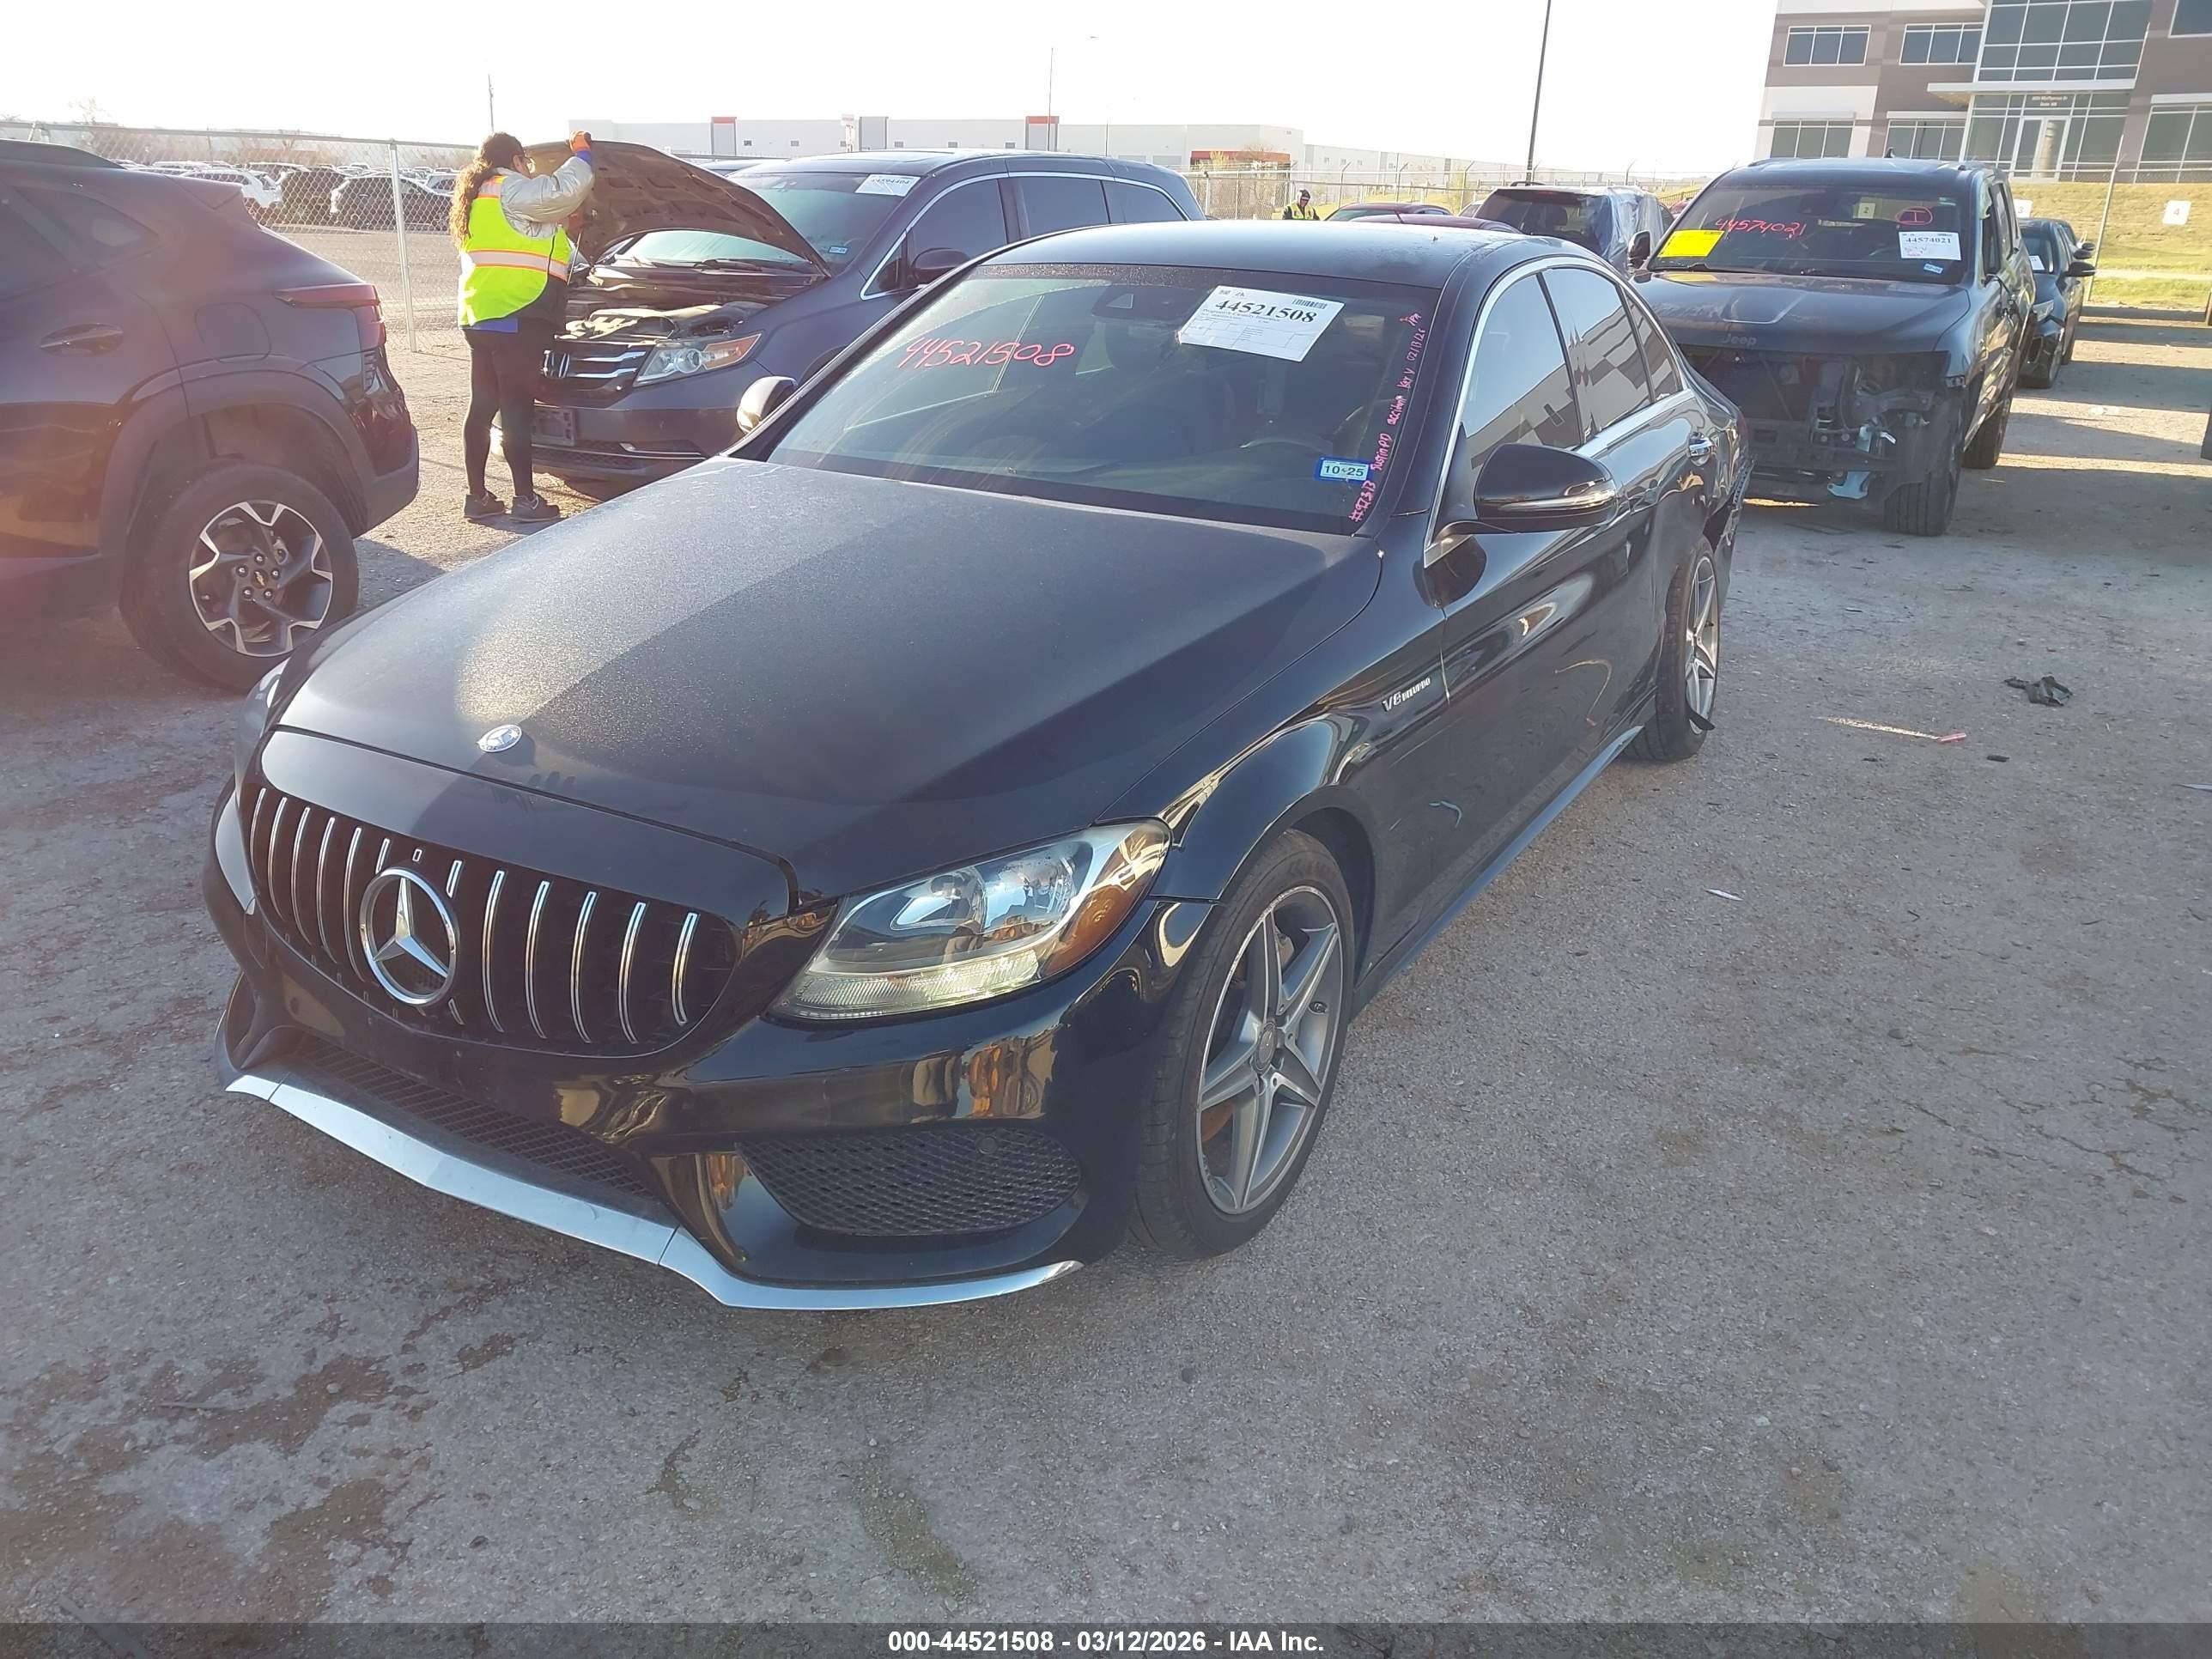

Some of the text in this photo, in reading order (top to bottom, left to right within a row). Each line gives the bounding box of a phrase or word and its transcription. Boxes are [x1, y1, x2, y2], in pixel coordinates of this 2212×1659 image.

[1715, 219, 1807, 236] 44574021
[1215, 300, 1318, 324] 44521508
[1719, 332, 1757, 349] Jeep
[897, 337, 1075, 369] 44521508
